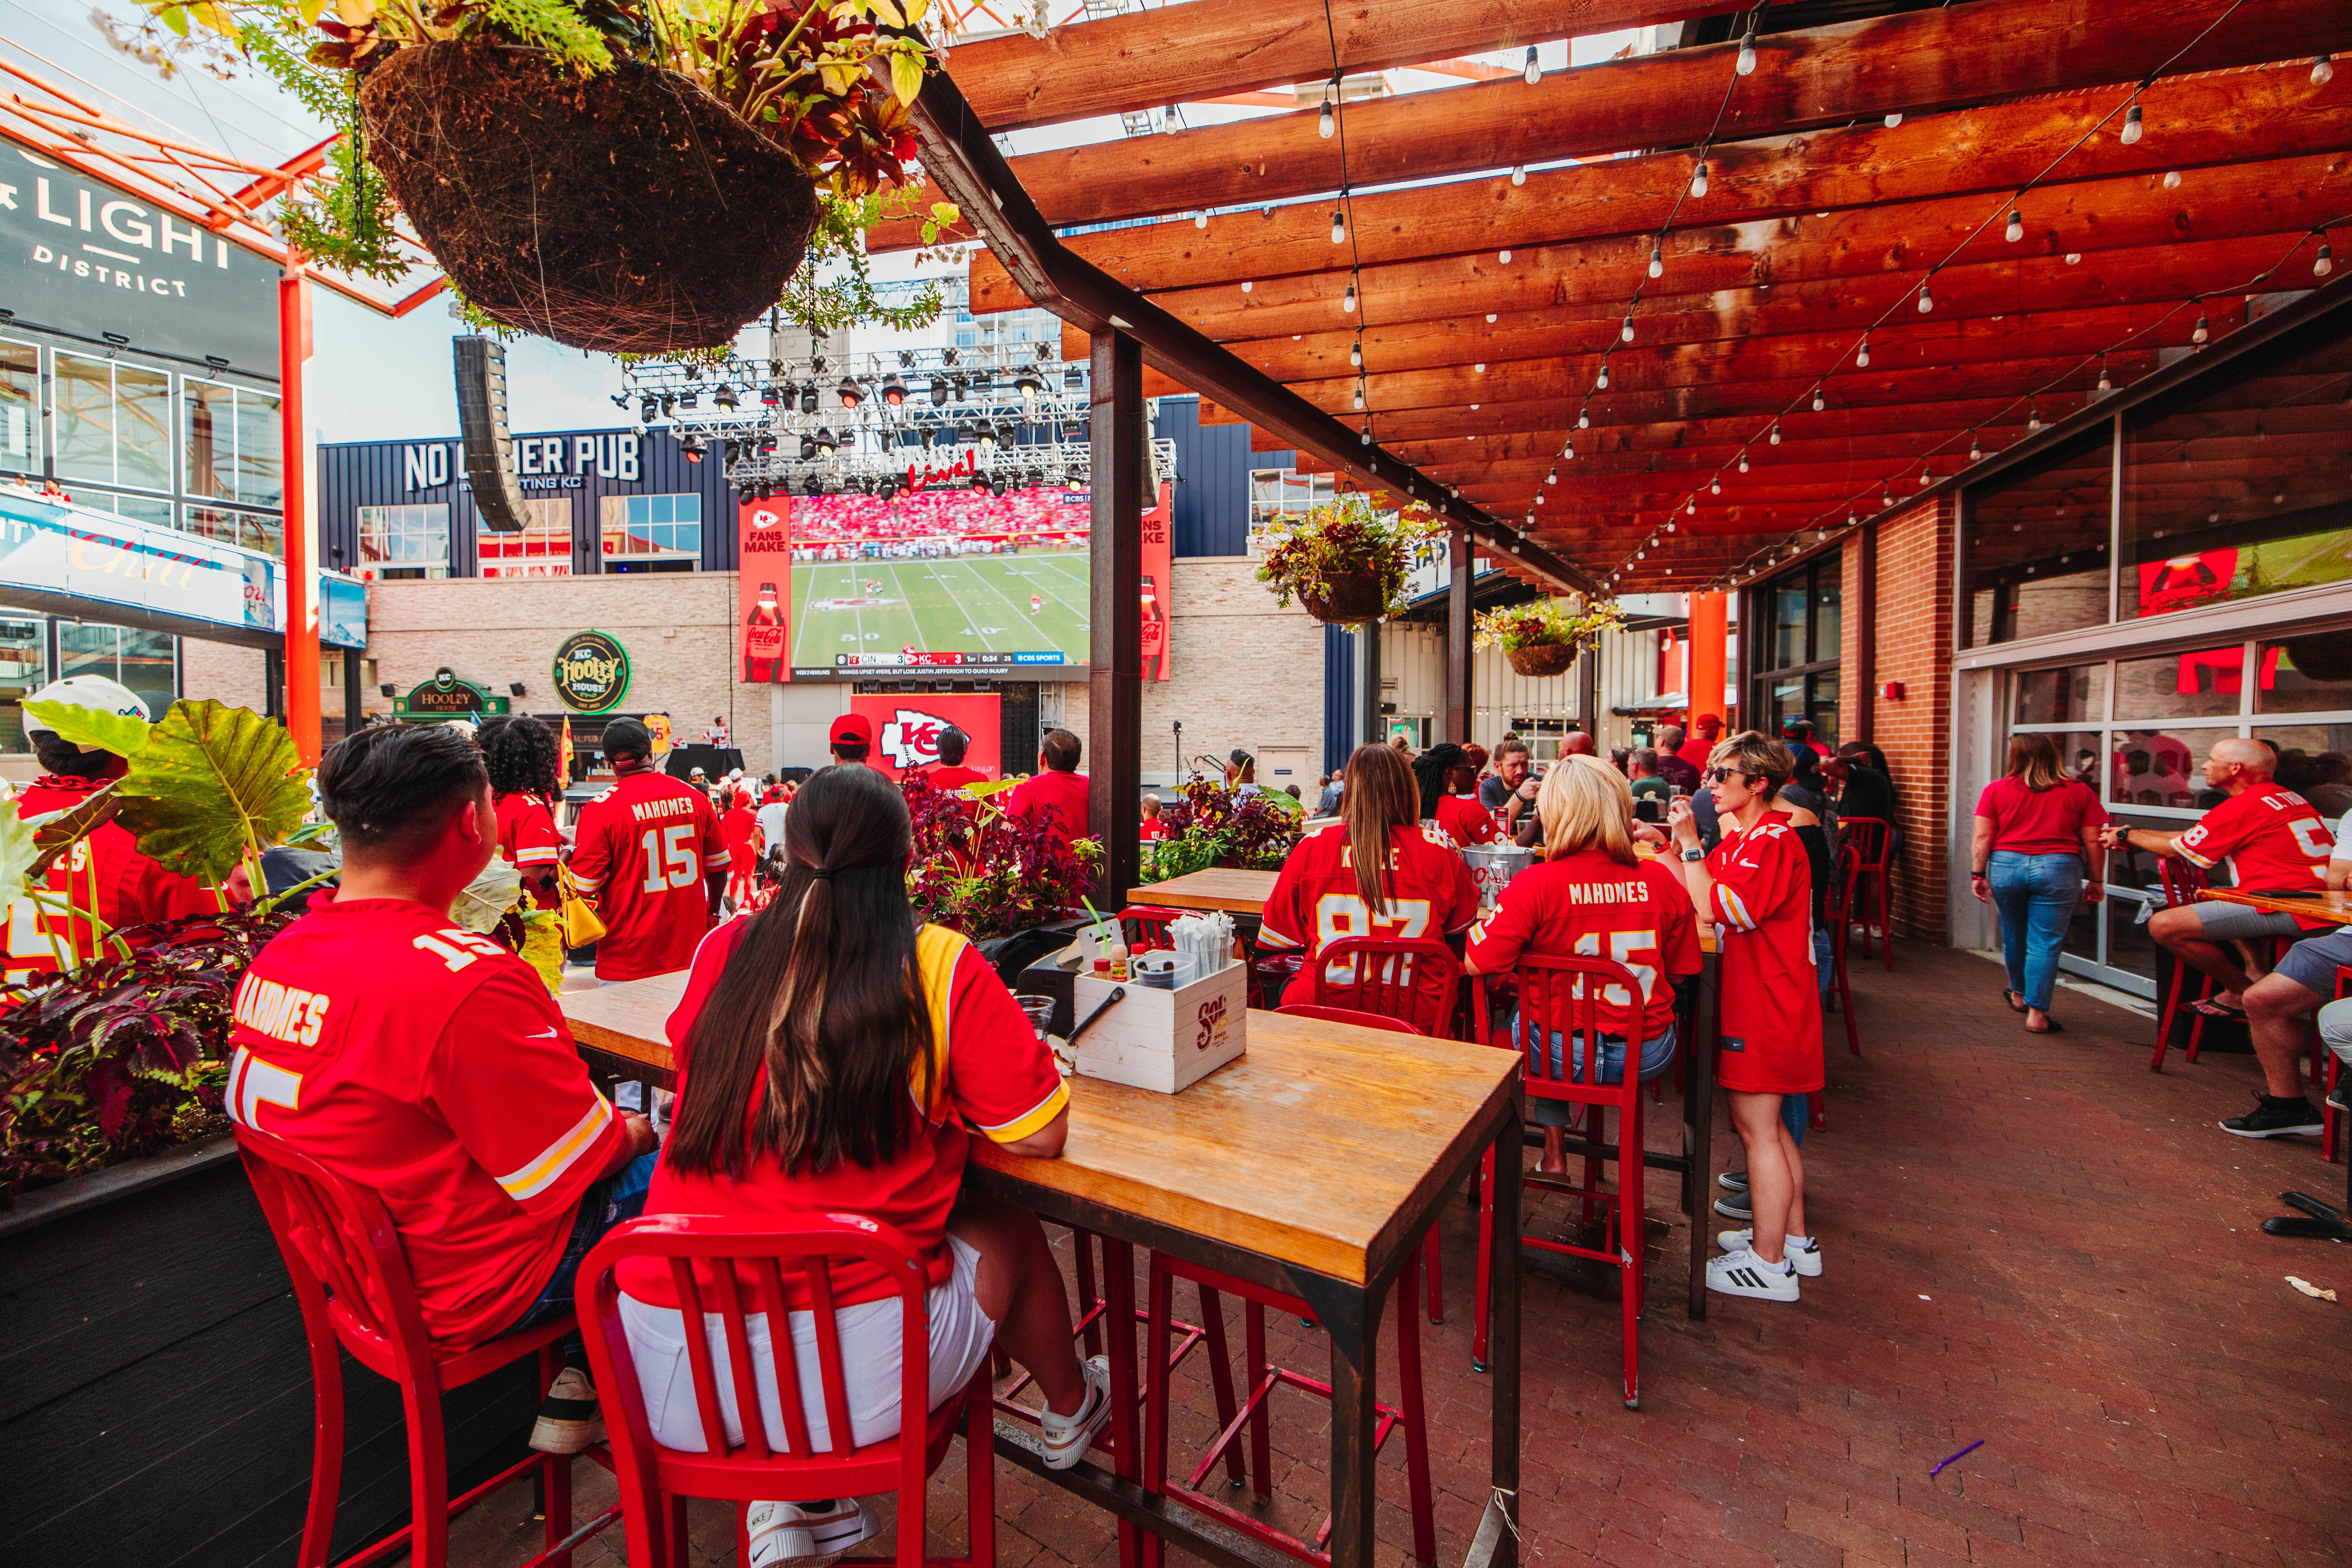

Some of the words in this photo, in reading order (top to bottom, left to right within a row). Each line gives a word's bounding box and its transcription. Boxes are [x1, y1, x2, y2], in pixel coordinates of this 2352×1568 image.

[33, 244, 187, 297] DISTRICT
[405, 443, 448, 492] NO
[575, 434, 639, 481] PUB
[561, 477, 582, 488] KC
[750, 531, 782, 541] FANS
[744, 541, 786, 553] MAKE
[69, 530, 209, 590] Chill
[574, 649, 592, 660] KC
[955, 654, 962, 664] 3
[438, 673, 451, 682] KC
[557, 657, 621, 687] HOOLEY
[572, 682, 606, 693] HOUSE
[422, 693, 470, 704] HOOLEY
[631, 797, 694, 822] MAHOMES
[1749, 823, 1788, 841] 87
[642, 824, 698, 893] 15
[1569, 881, 1649, 905] MAHOMES
[1315, 893, 1430, 986] 87
[412, 928, 506, 973] 15
[1571, 929, 1658, 1006] 15
[235, 971, 330, 1047] MAHOMES
[1045, 1430, 1058, 1438] NIKE
[752, 1512, 766, 1527] NIKE
